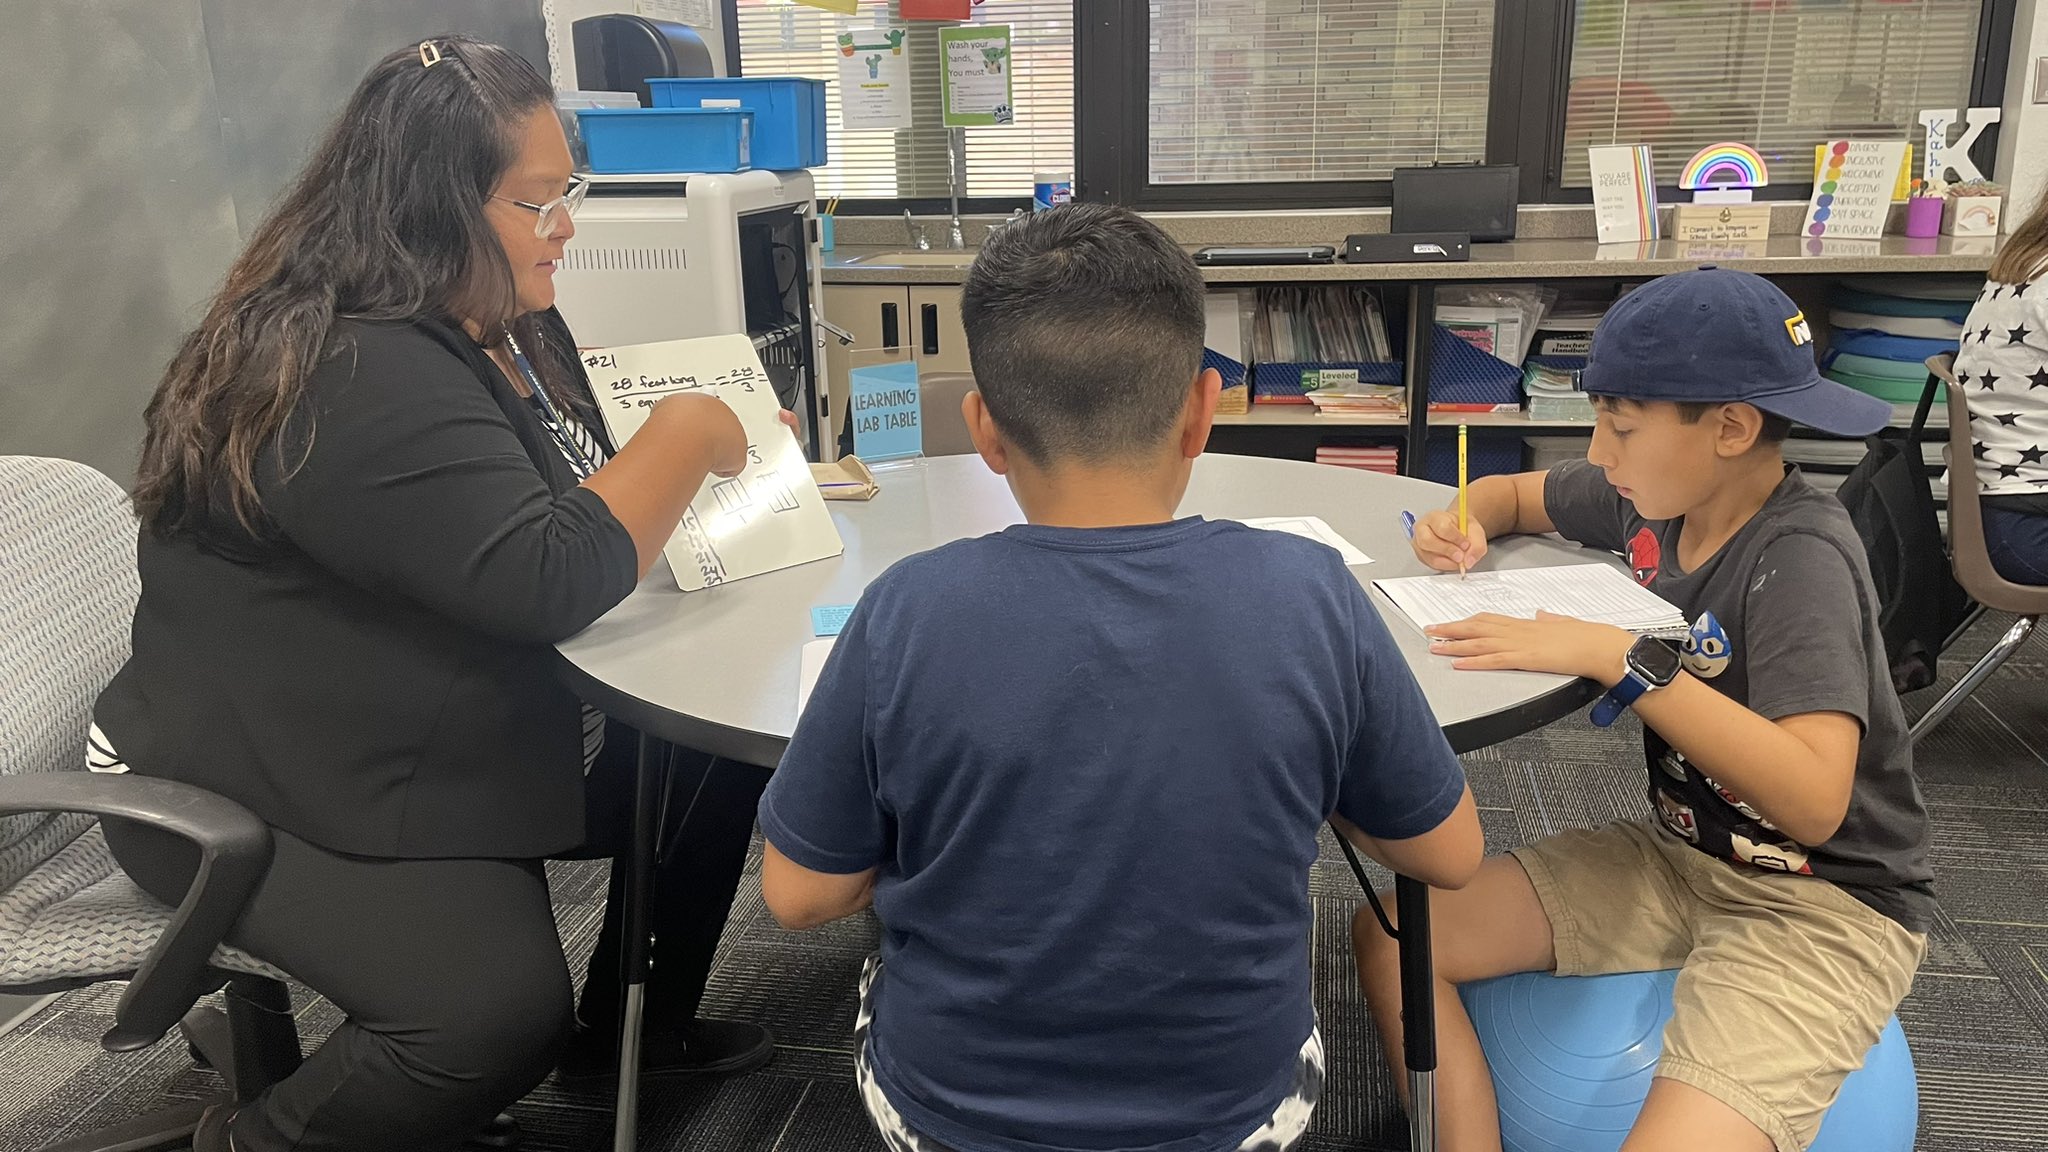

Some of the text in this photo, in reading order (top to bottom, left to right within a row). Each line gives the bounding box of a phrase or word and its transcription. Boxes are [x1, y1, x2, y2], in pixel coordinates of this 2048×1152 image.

[947, 41, 989, 50] Wash your
[948, 54, 973, 63] hands,
[1846, 156, 1885, 166] INCLUSIVE
[1841, 170, 1884, 178] WELCOMING
[1600, 178, 1631, 187] PERFECT
[1838, 183, 1880, 193] ACCEPTING
[1849, 210, 1874, 219] SPACE
[1827, 224, 1841, 233] FOR
[584, 354, 618, 369] #21
[731, 366, 754, 376] 28
[610, 377, 633, 391] 28
[1310, 377, 1318, 388] 5
[1321, 372, 1356, 380] Leveled
[741, 382, 755, 392] 3
[854, 388, 917, 411] LEARNING
[856, 411, 917, 434] LAB TABLE
[748, 450, 763, 464] 3
[681, 516, 696, 532] 15
[695, 551, 711, 563] 21
[700, 565, 719, 577] 24
